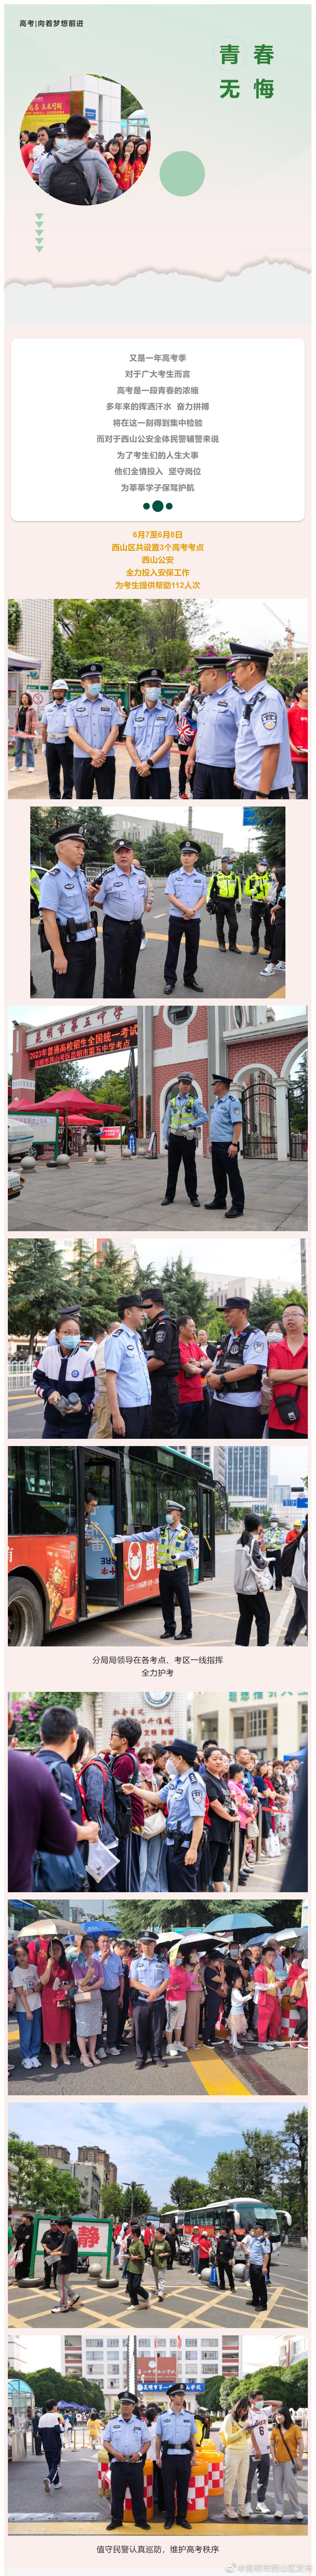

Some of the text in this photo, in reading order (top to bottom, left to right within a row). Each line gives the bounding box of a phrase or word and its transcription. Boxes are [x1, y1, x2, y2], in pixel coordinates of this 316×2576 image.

[35, 1006, 123, 1044] 昆明市第五中学
[30, 1024, 138, 1060] 2023年普通高校招生全国统一考试
[35, 1039, 130, 1067] 昆明市西山考区昆明市第五中学考点
[78, 2226, 100, 2248] 静
[259, 2426, 264, 2436] 6
